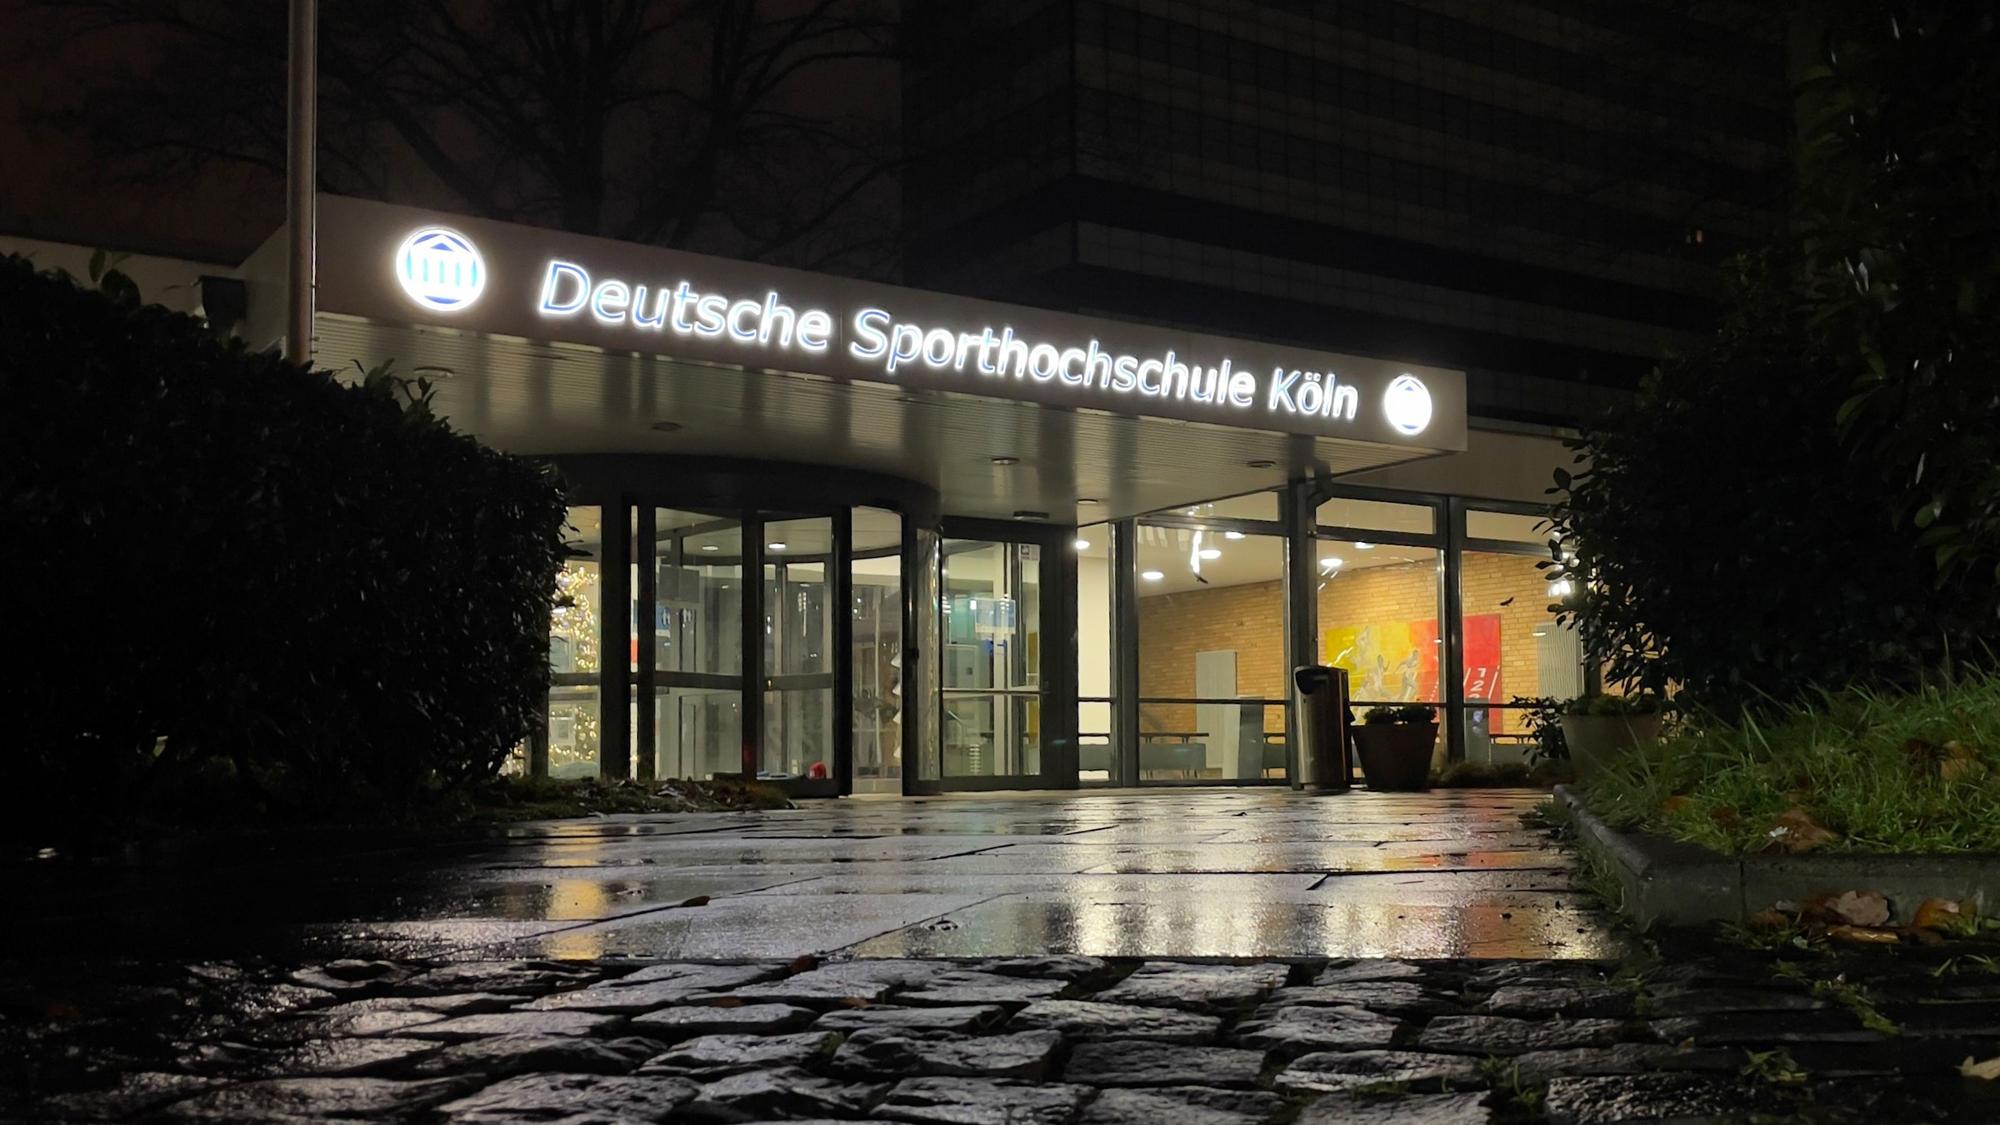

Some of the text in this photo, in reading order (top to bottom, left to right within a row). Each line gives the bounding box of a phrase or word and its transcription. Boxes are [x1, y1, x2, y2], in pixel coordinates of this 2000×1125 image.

[538, 260, 1359, 420] Deutsche Sporthochschule Köln
